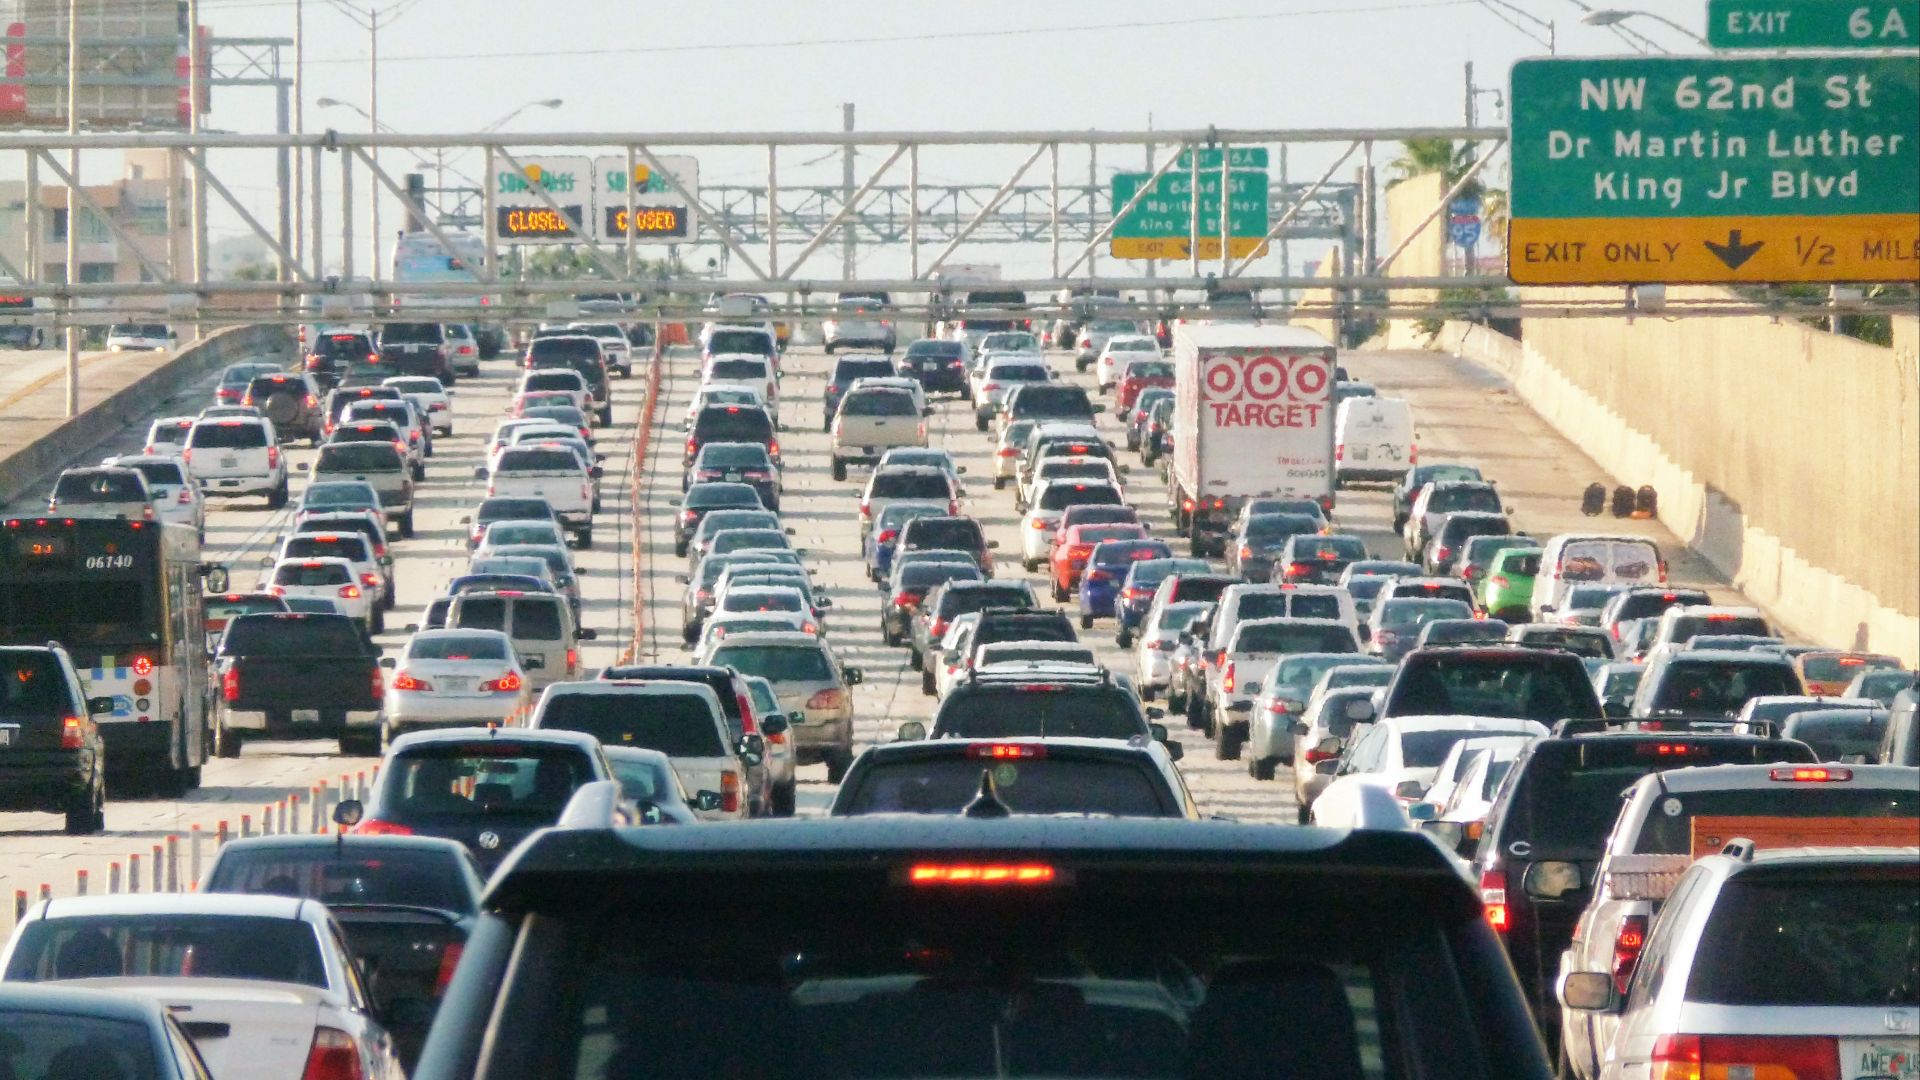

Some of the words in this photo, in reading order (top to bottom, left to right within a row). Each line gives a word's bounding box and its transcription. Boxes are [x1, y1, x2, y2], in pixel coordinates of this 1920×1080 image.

[1727, 11, 1792, 34] EXIT
[1848, 8, 1908, 38] 6A
[1580, 78, 1646, 111] NW
[1675, 76, 1796, 110] 62nd
[1825, 75, 1873, 109] St
[1231, 153, 1254, 164] 6A
[1548, 131, 1591, 159] Dr
[1614, 130, 1747, 159] Martin
[1768, 129, 1903, 158] Luther
[1594, 172, 1683, 209] King
[1707, 172, 1748, 200] Jr
[1771, 170, 1858, 199] Blvd
[615, 210, 676, 231] COSED
[1525, 243, 1587, 264] EXIT
[1604, 242, 1681, 264] ONLY
[1795, 235, 1836, 267] 1/2
[1209, 403, 1323, 427] TARGET
